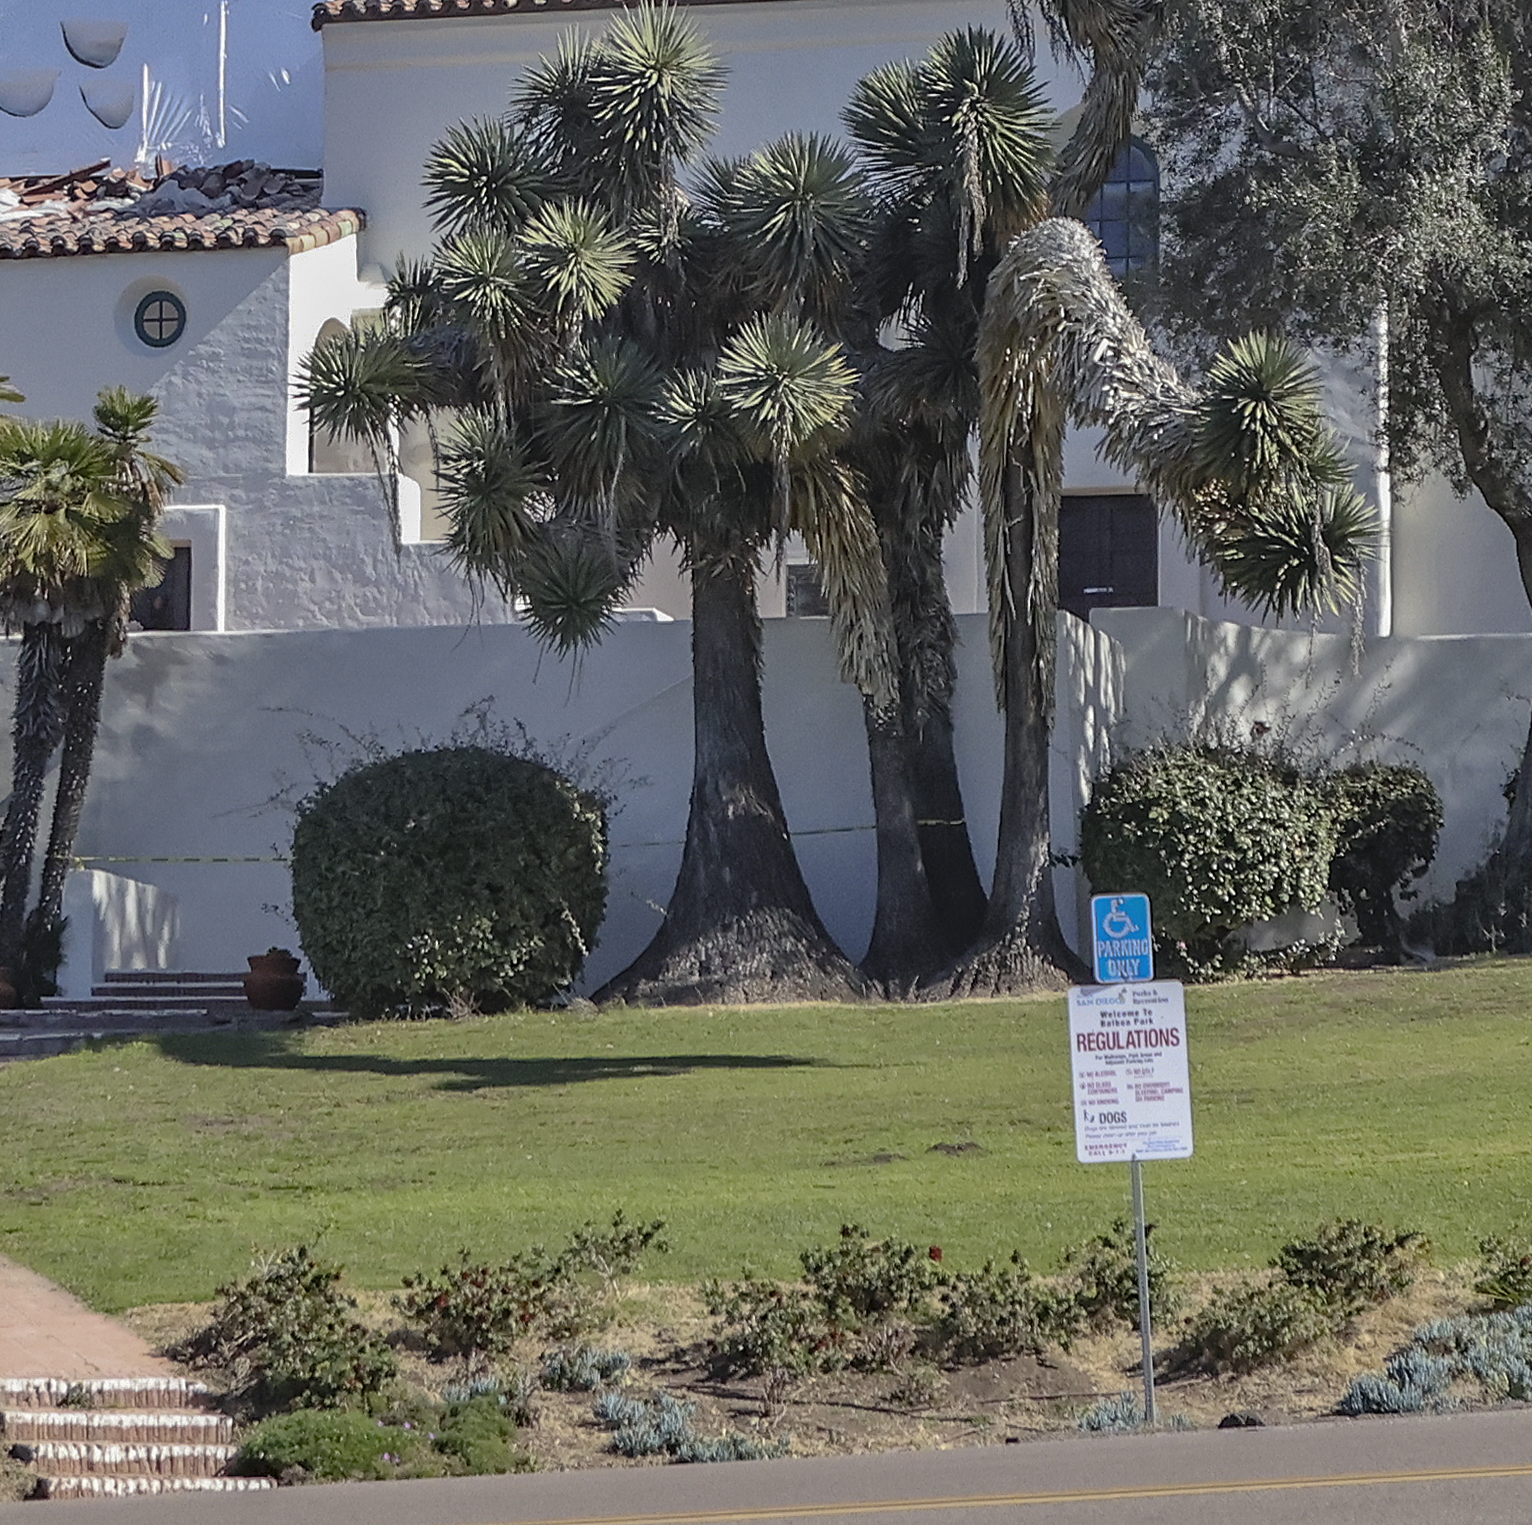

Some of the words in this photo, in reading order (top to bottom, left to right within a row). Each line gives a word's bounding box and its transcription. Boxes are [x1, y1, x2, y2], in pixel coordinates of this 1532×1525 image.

[1097, 938, 1149, 958] PARKING
[1108, 958, 1140, 978] ONLY
[1100, 1009, 1139, 1018] Welcome
[1143, 1008, 1153, 1016] To
[1134, 1018, 1154, 1026] Park
[1076, 1027, 1180, 1052] REGULATIONS
[1099, 1111, 1128, 1124] DOGS
